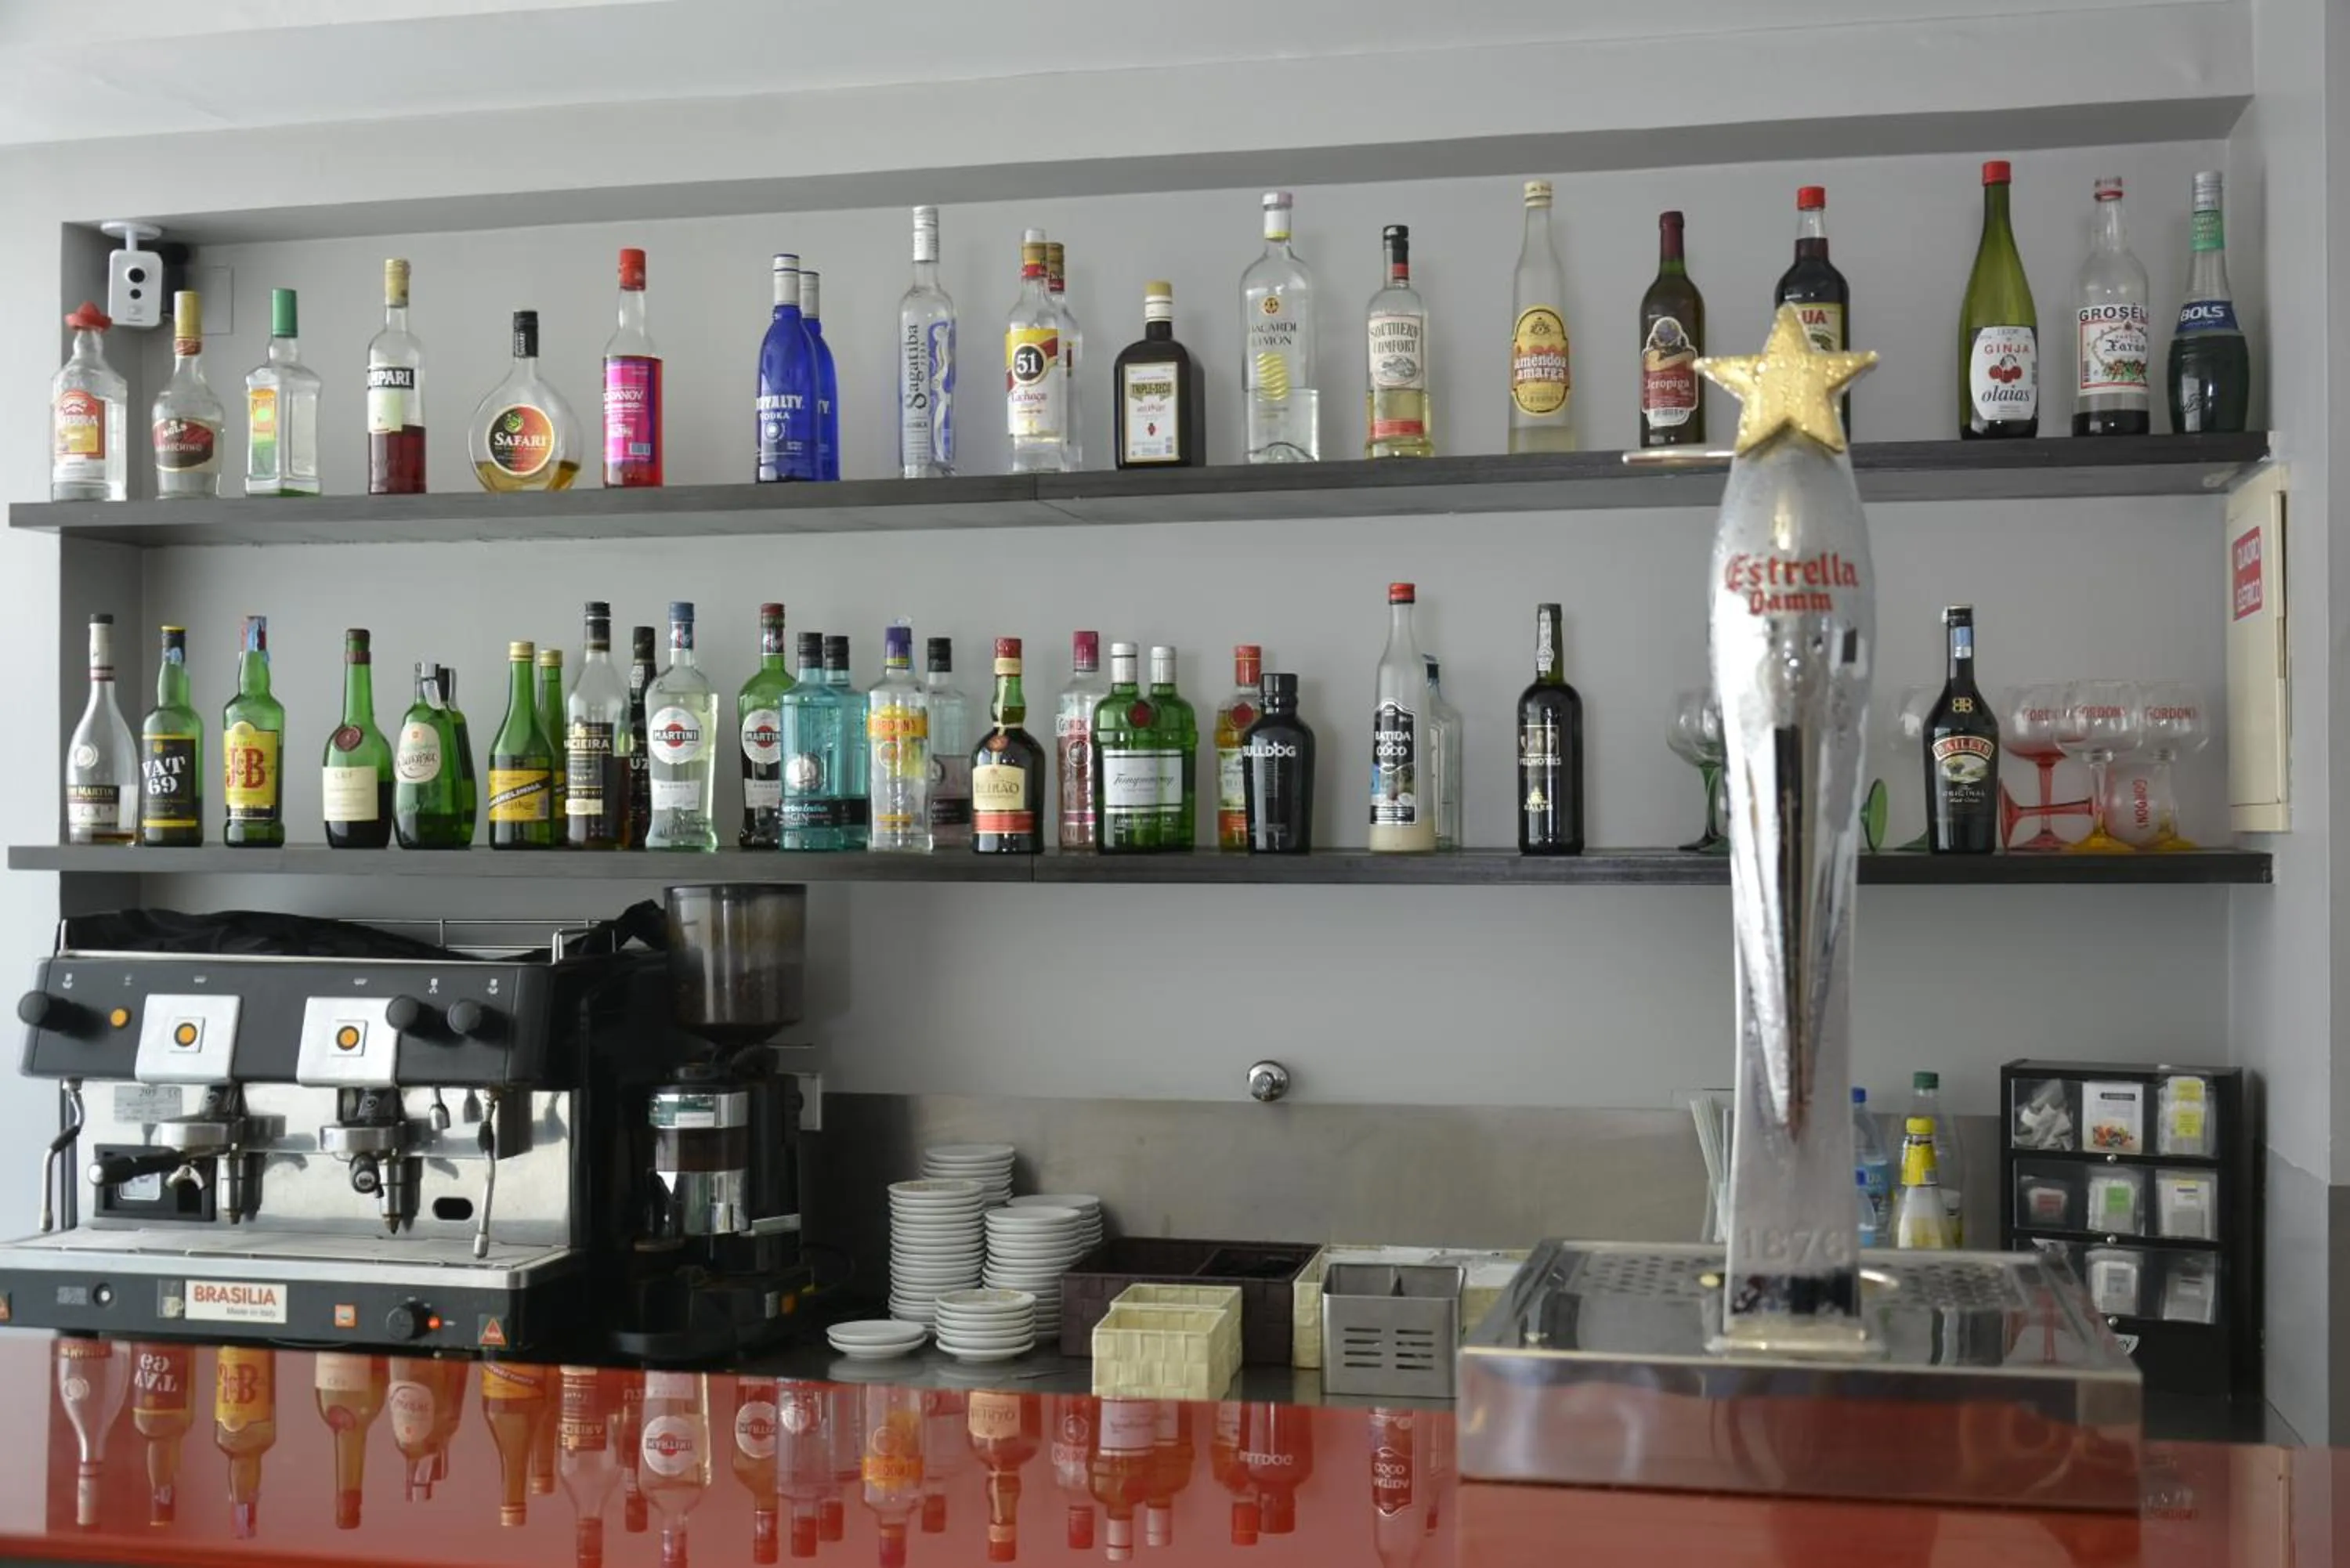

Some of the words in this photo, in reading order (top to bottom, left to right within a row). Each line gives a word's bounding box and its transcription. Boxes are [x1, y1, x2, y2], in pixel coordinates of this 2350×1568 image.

[2180, 305, 2225, 322] BOLS
[1983, 344, 2030, 355] GINJA
[1016, 352, 1039, 374] 51
[1981, 385, 2030, 402] olaias
[494, 432, 546, 446] SAFARI
[1725, 551, 1860, 592] Estrella
[1748, 589, 1833, 616] Damm
[653, 731, 697, 740] MARTINI
[1936, 737, 1991, 757] BAILEYS
[142, 755, 186, 779] VAT
[147, 775, 178, 796] 69
[193, 1284, 277, 1306] BRASILIA
